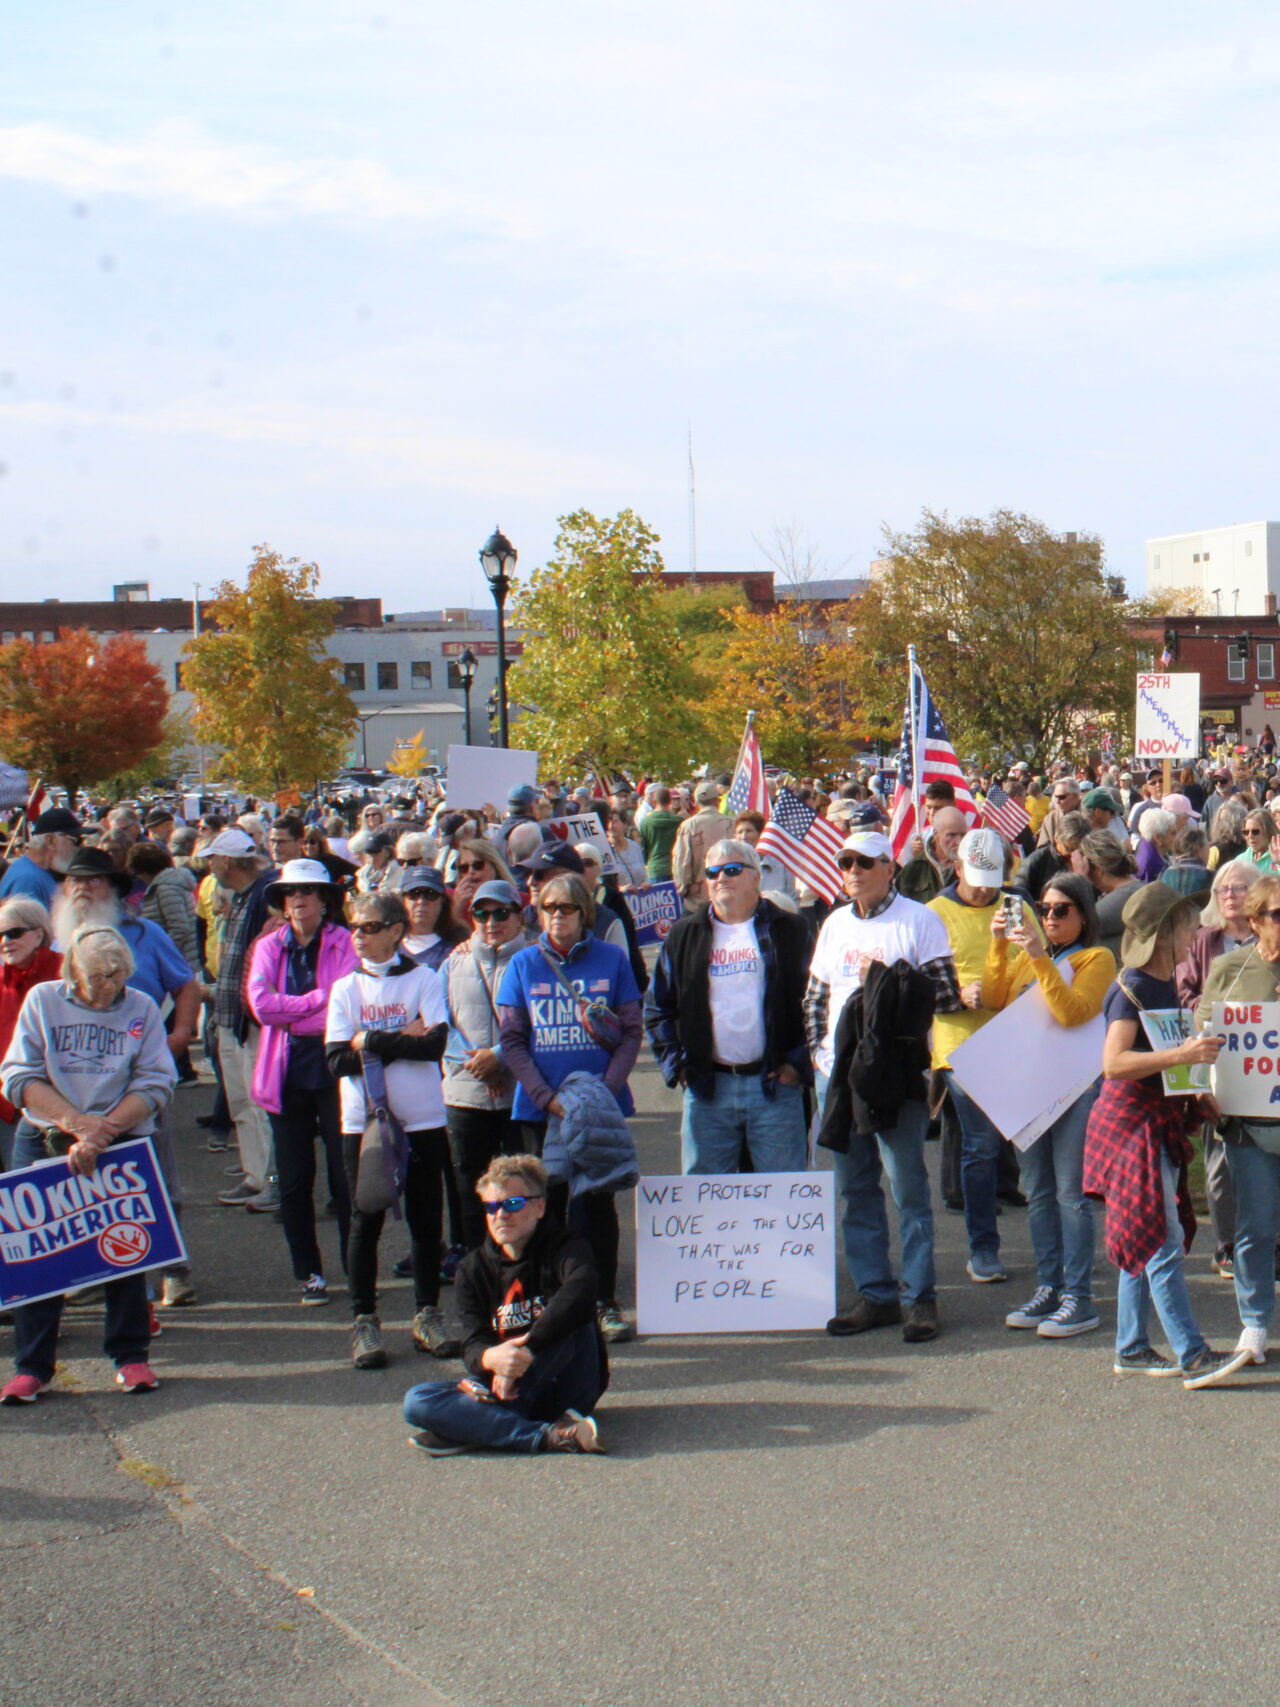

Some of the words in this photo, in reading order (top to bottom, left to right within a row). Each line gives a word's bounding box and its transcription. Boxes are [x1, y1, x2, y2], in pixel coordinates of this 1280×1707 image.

[1138, 675, 1170, 689] 25TH
[1140, 689, 1192, 749] AMENDMENT
[1138, 738, 1180, 755] NOW
[569, 820, 600, 839] THE
[641, 889, 675, 913] KINGS
[636, 907, 676, 928] MERICA
[710, 949, 726, 965] NO
[728, 948, 758, 962] KINGS
[844, 948, 859, 965] NO
[717, 961, 757, 976] AMERICA
[555, 979, 585, 997] NO
[361, 1004, 376, 1021] NO
[377, 1003, 408, 1018] KINGS
[1224, 1004, 1264, 1025] DUE
[50, 1023, 128, 1056] NEWPORT
[536, 1025, 596, 1046] AMERI
[0, 1182, 46, 1233] NO
[45, 1160, 148, 1220] KINGS
[642, 1185, 684, 1205] WE
[698, 1182, 772, 1204] PROTEST
[789, 1184, 823, 1200] FOR
[5, 1242, 25, 1260] in
[28, 1197, 150, 1257] AMERICA
[652, 1214, 704, 1237] LOVE
[717, 1220, 739, 1231] OF
[753, 1217, 777, 1231] THE
[786, 1212, 825, 1232] USA
[677, 1243, 726, 1259] THAT
[733, 1243, 760, 1256] WAS
[779, 1240, 815, 1257] FOR
[718, 1259, 744, 1270] THE
[675, 1279, 777, 1304] PEOPLE
